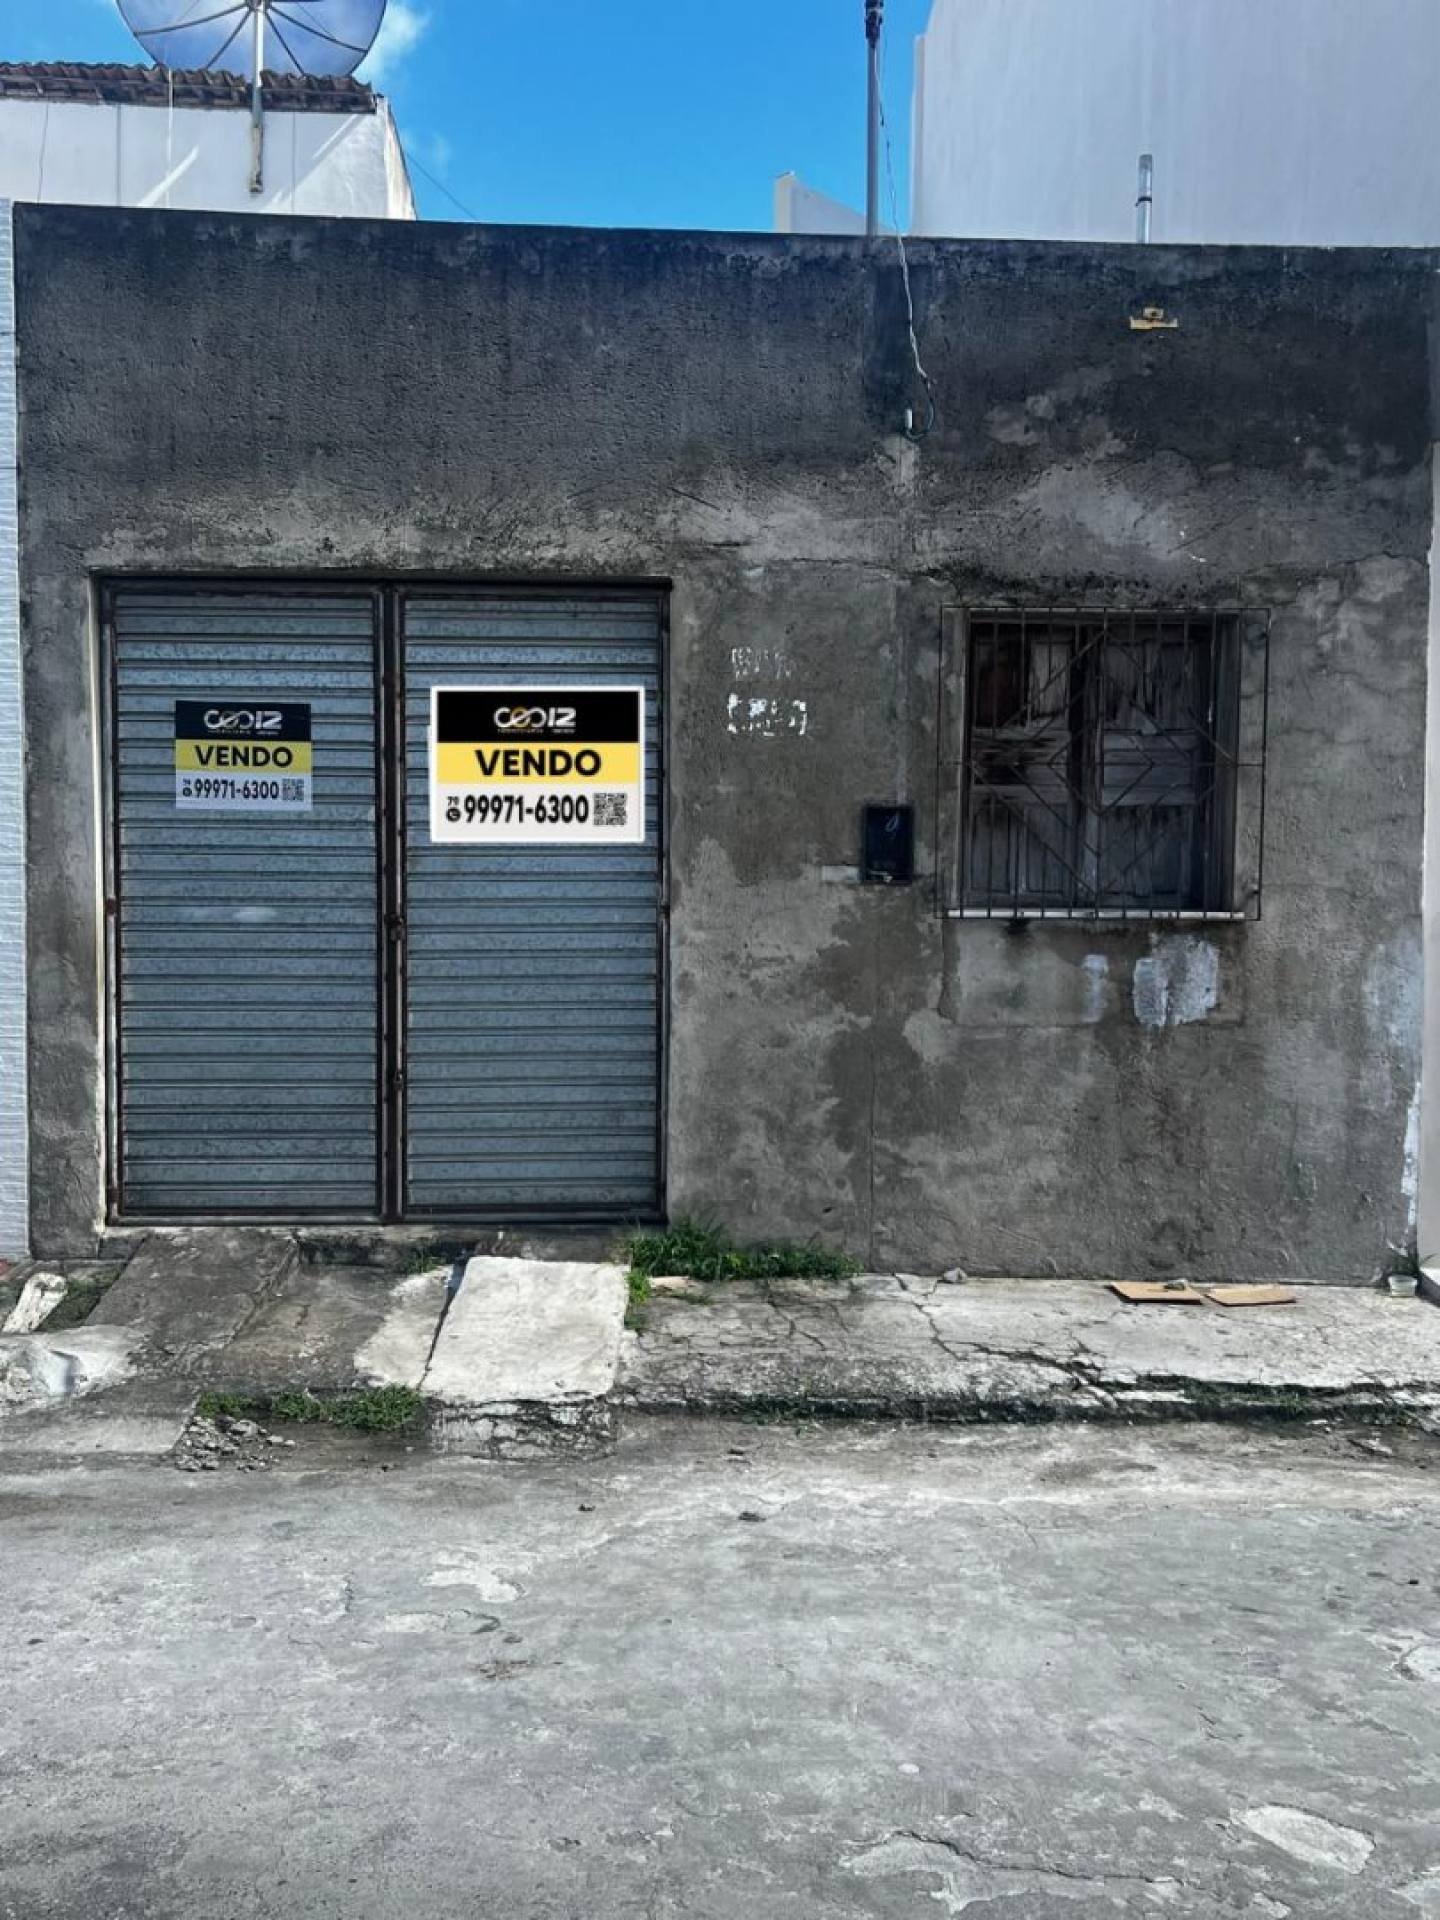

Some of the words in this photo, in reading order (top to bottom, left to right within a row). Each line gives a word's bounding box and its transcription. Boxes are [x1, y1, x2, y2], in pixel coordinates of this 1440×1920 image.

[194, 744, 294, 769] VENDO
[475, 749, 603, 777] VENDO
[193, 778, 280, 799] 99971-6300
[463, 794, 590, 824] 99971-6300
